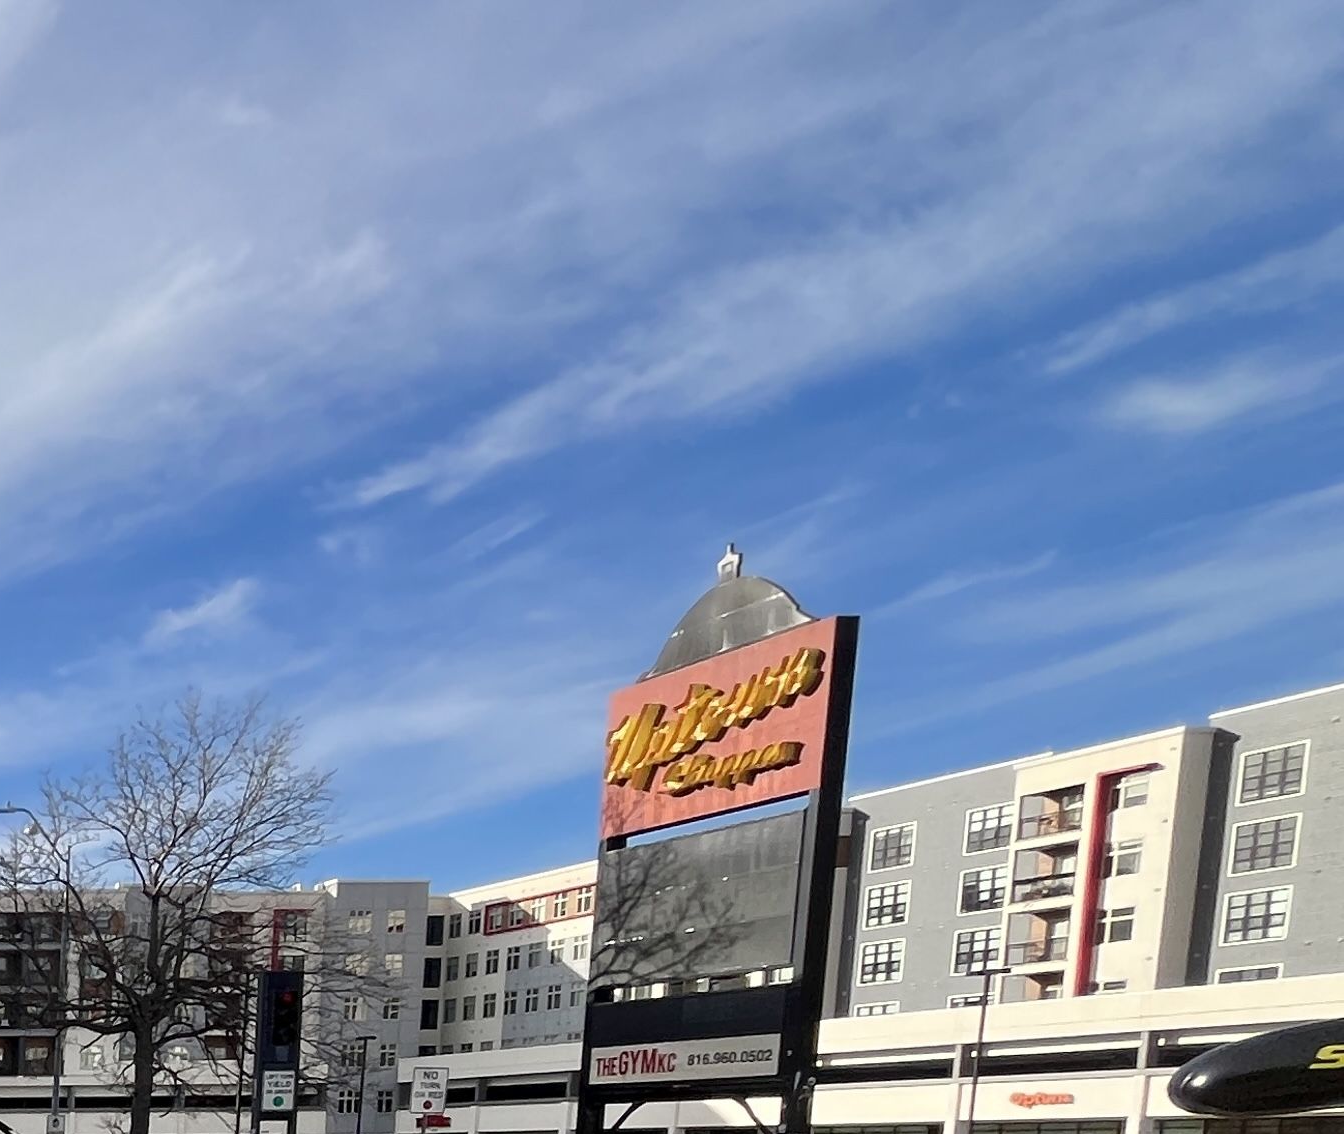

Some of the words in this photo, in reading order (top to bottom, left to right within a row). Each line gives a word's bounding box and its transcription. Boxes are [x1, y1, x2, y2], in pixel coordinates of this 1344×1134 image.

[687, 1049, 773, 1066] 816.960.0502
[423, 1071, 439, 1080] NO
[267, 1080, 292, 1088] YIELD
